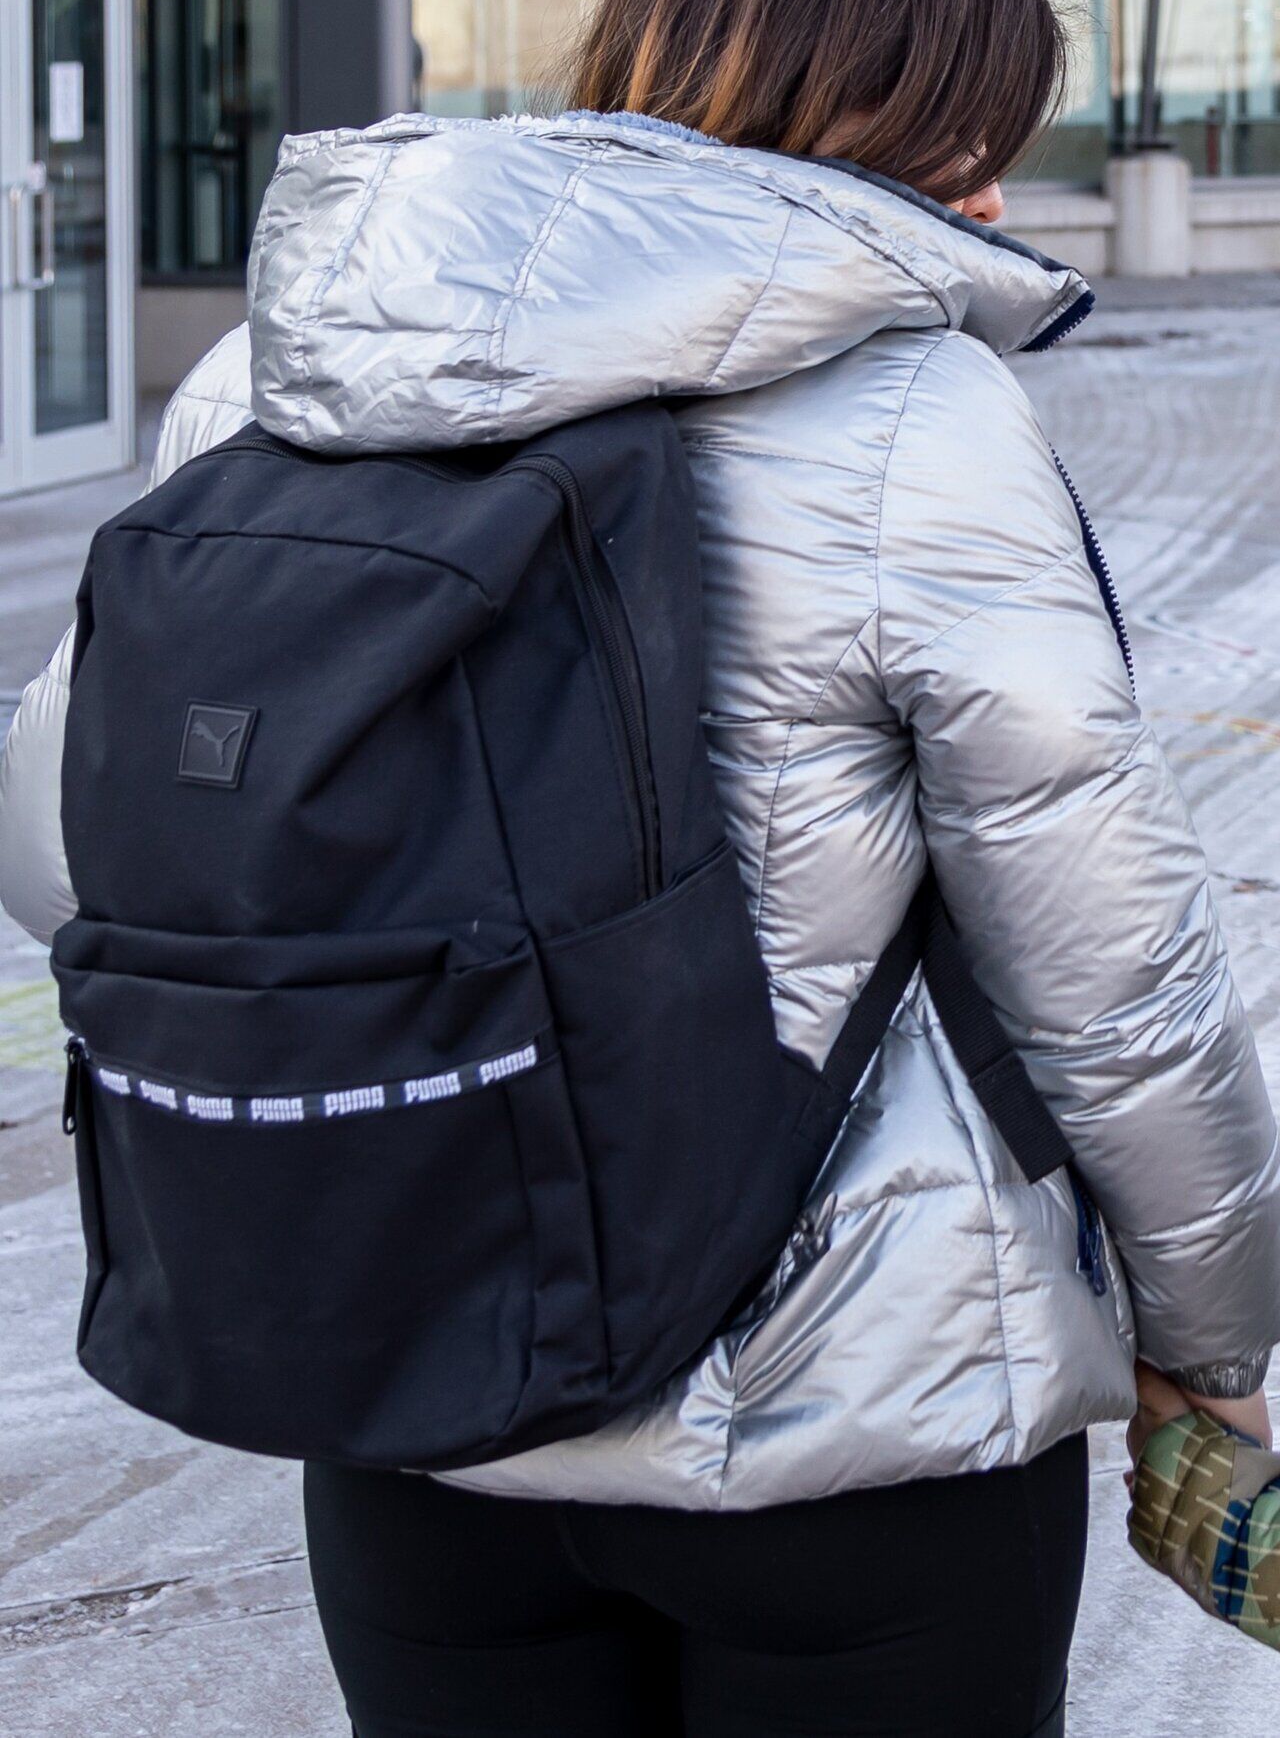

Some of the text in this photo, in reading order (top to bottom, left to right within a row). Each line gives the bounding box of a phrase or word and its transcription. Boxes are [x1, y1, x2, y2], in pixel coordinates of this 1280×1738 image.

[186, 1094, 234, 1121] PUMA
[249, 1097, 305, 1121] PUMA
[323, 1085, 385, 1117] PUMA
[403, 1071, 462, 1104] PUMA
[478, 1044, 537, 1085] PUMA
